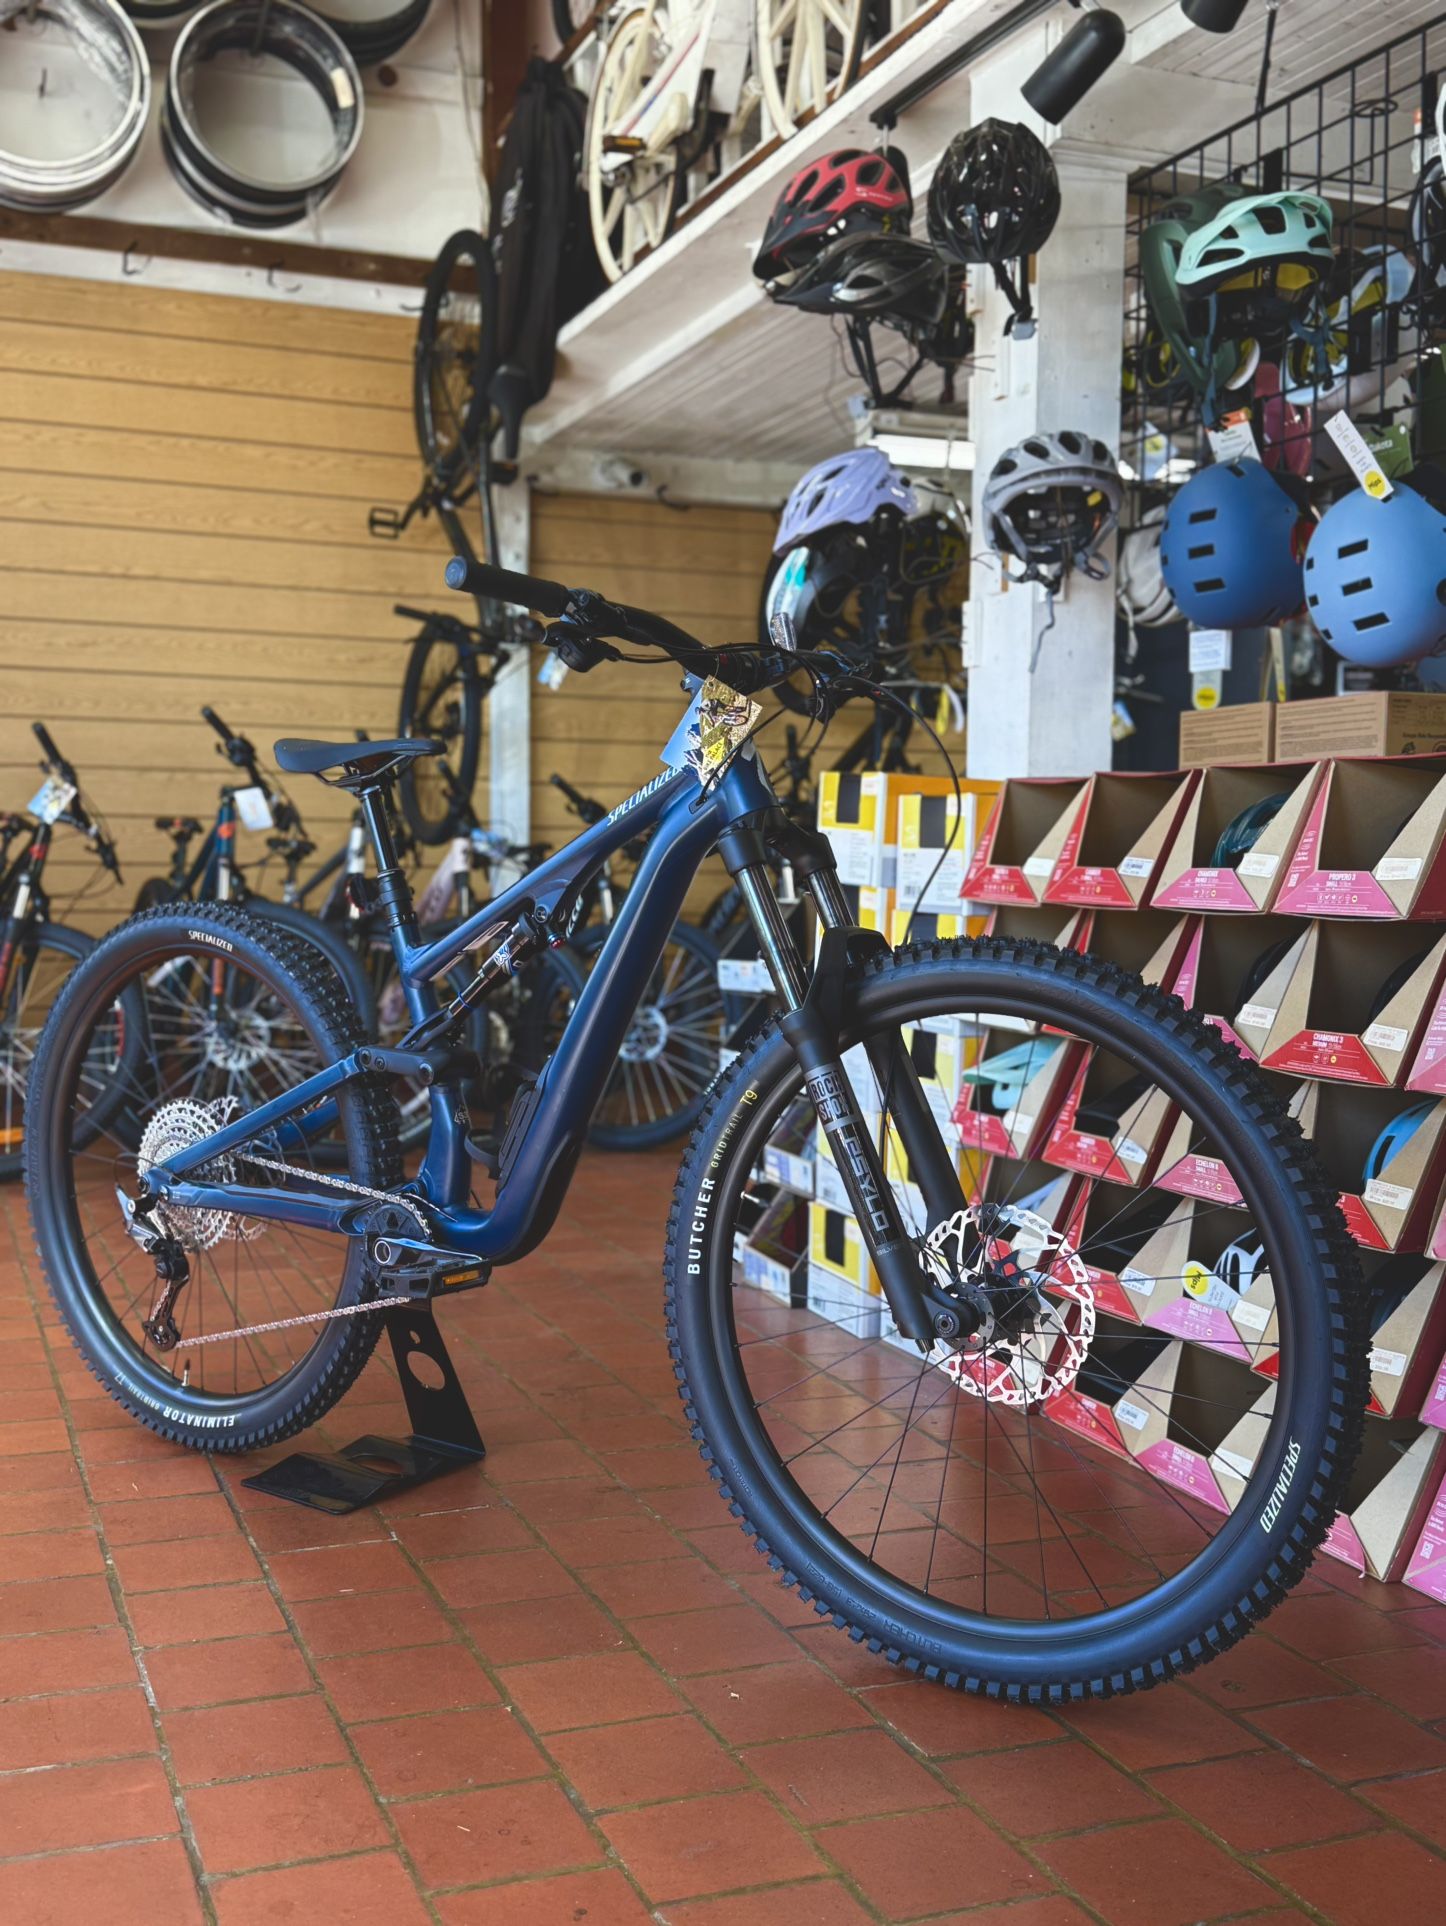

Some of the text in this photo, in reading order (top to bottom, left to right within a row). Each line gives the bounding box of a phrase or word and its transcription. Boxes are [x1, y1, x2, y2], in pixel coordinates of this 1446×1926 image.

[188, 930, 233, 952] SPECIALIZED
[687, 1177, 715, 1275] BUTCHER
[739, 1089, 758, 1106] T9
[163, 1405, 236, 1429] ELIMINATOR
[1259, 1435, 1302, 1534] SPECIALIZED
